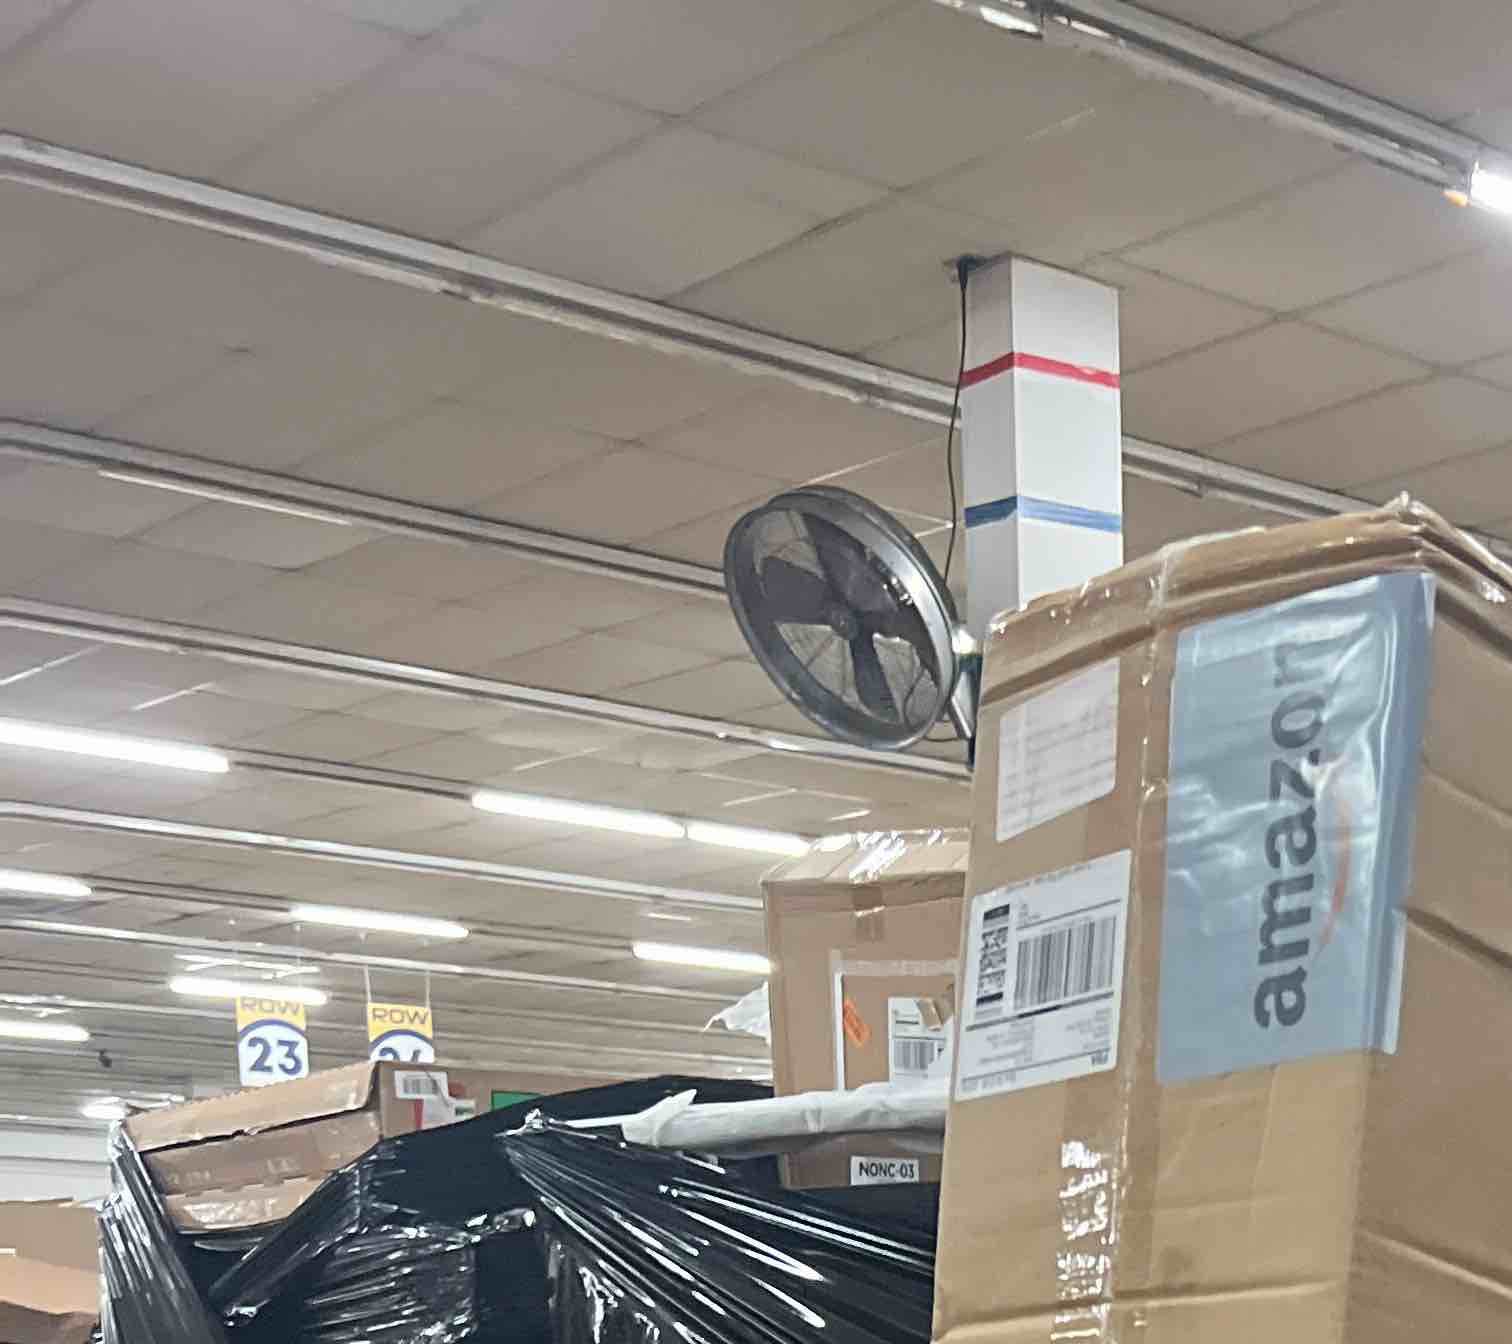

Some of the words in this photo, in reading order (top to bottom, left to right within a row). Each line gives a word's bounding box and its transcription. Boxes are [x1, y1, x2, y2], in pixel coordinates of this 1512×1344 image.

[1252, 636, 1340, 1030] amazon
[372, 1006, 428, 1025] ROW
[247, 1036, 303, 1076] 23
[858, 1161, 915, 1179] NONC-03
